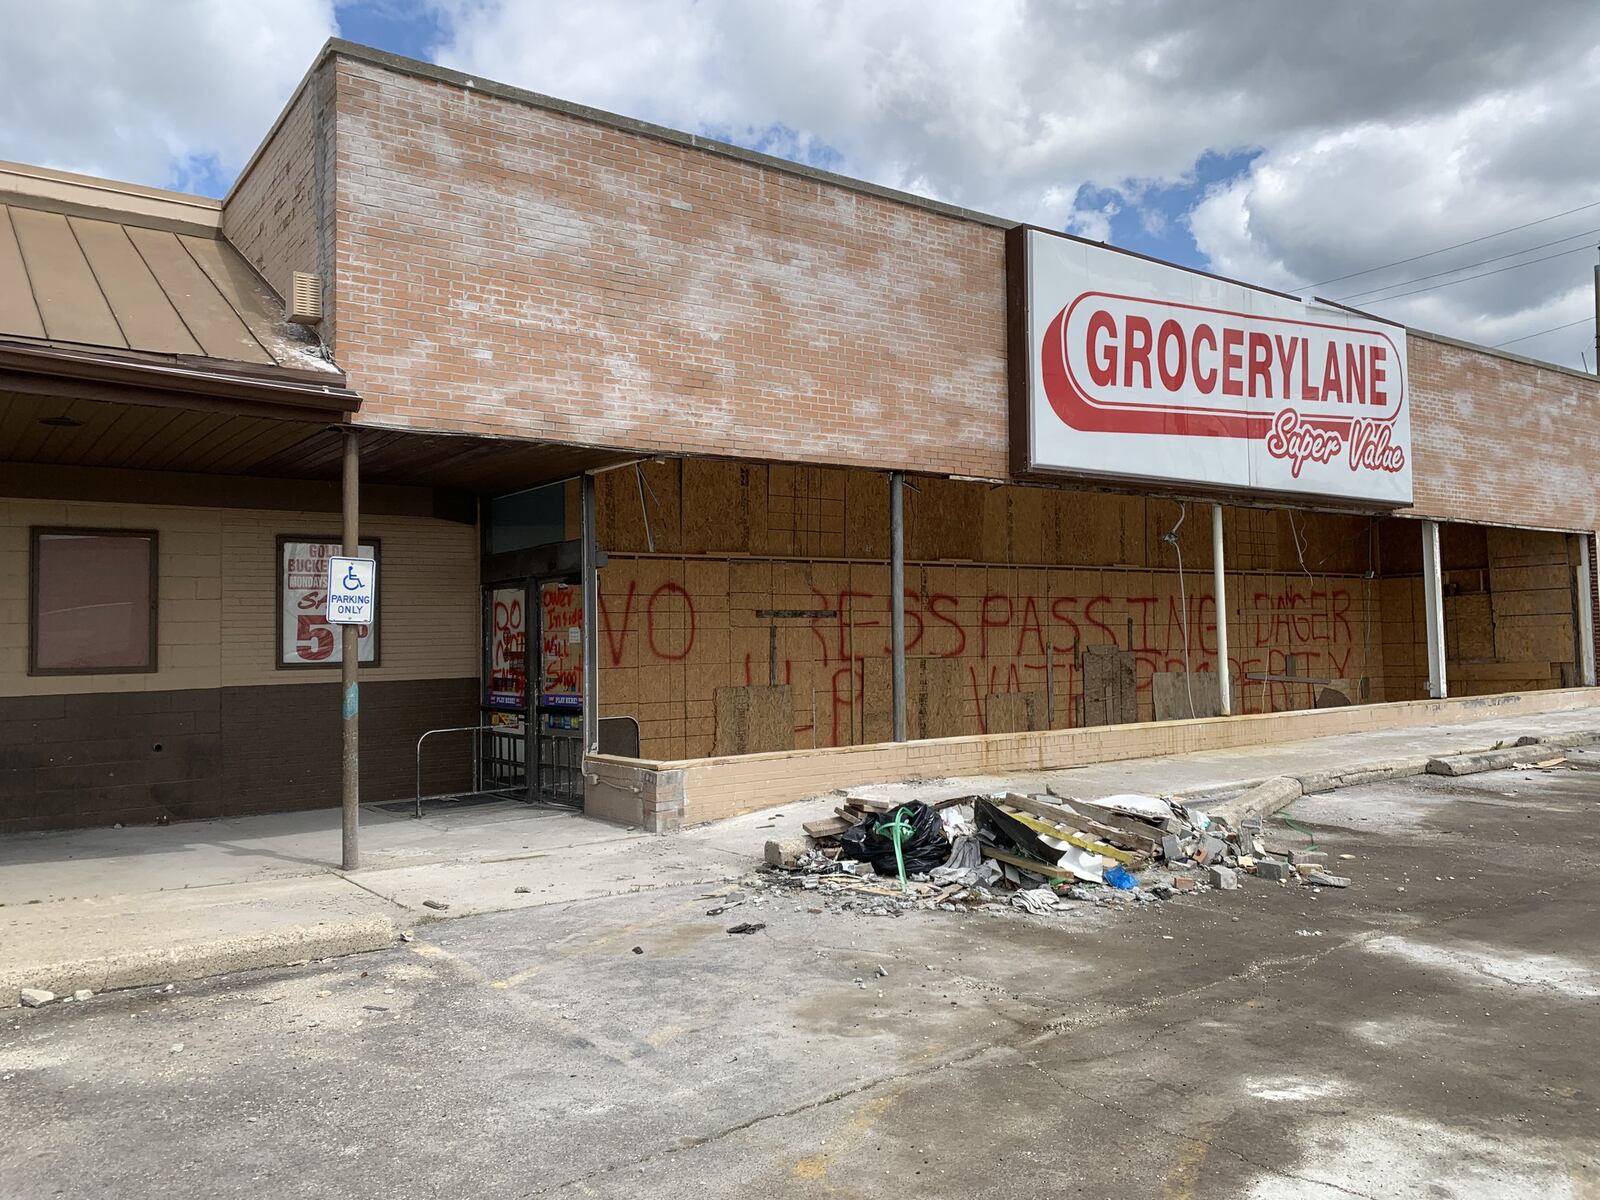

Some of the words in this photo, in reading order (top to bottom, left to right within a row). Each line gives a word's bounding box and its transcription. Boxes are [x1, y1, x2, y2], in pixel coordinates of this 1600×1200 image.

[1086, 309, 1388, 406] GROCERYLANE
[1267, 407, 1342, 478] Super
[1349, 416, 1404, 473] Value
[309, 545, 341, 557] GOLD
[288, 559, 328, 572] BUCKE
[331, 594, 370, 604] PARKING
[337, 605, 363, 614] ONLY
